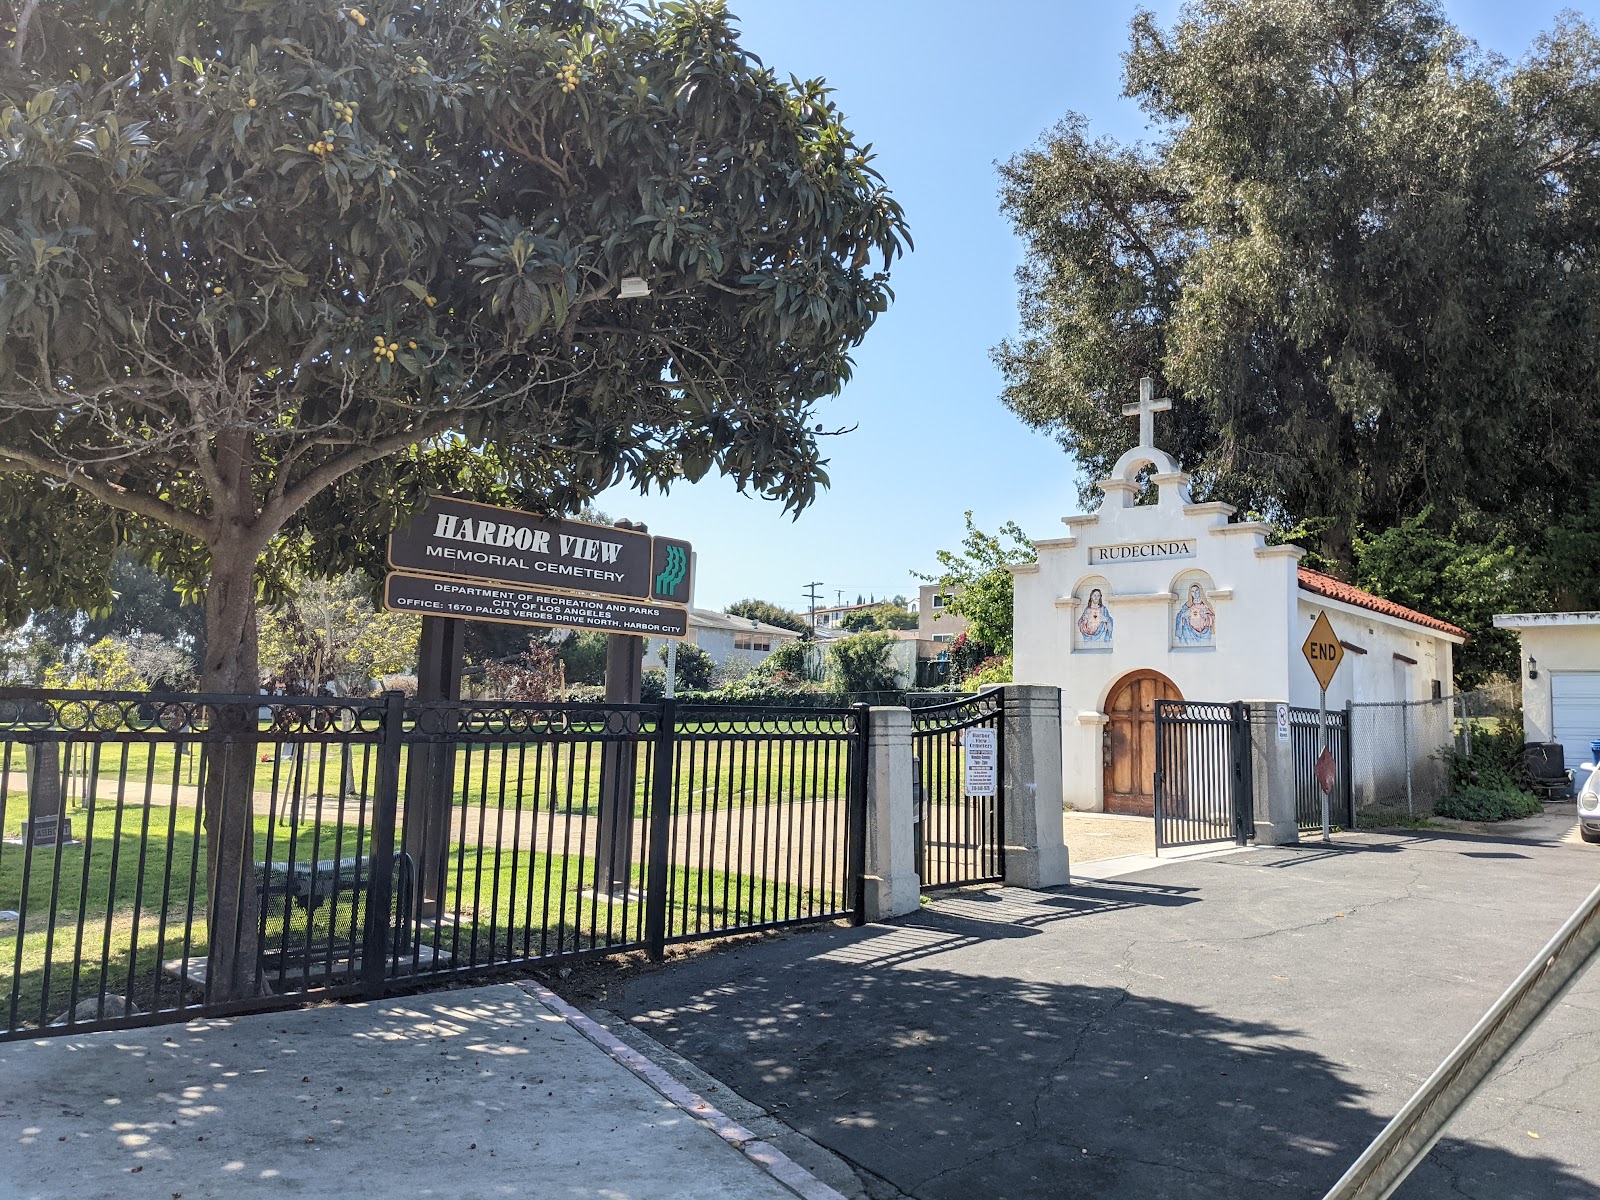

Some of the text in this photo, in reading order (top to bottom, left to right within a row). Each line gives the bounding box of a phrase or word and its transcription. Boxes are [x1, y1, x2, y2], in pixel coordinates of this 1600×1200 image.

[433, 513, 623, 565] HARBOR VIEW
[1099, 542, 1190, 560] RUDECINDA
[426, 545, 625, 582] MEMORIAL CEMETERY
[434, 584, 660, 616] DEPARTMENT OF RECREATION AND PARKS
[492, 600, 519, 609] CITY
[540, 604, 561, 613] LOS
[563, 608, 611, 619] ANGELES
[397, 598, 681, 633] OFFICE: 1670 PALOS VERDES DRIVE NORTH, HARBOR CITY
[1310, 641, 1336, 661] END
[36, 826, 68, 837] ABBOT
